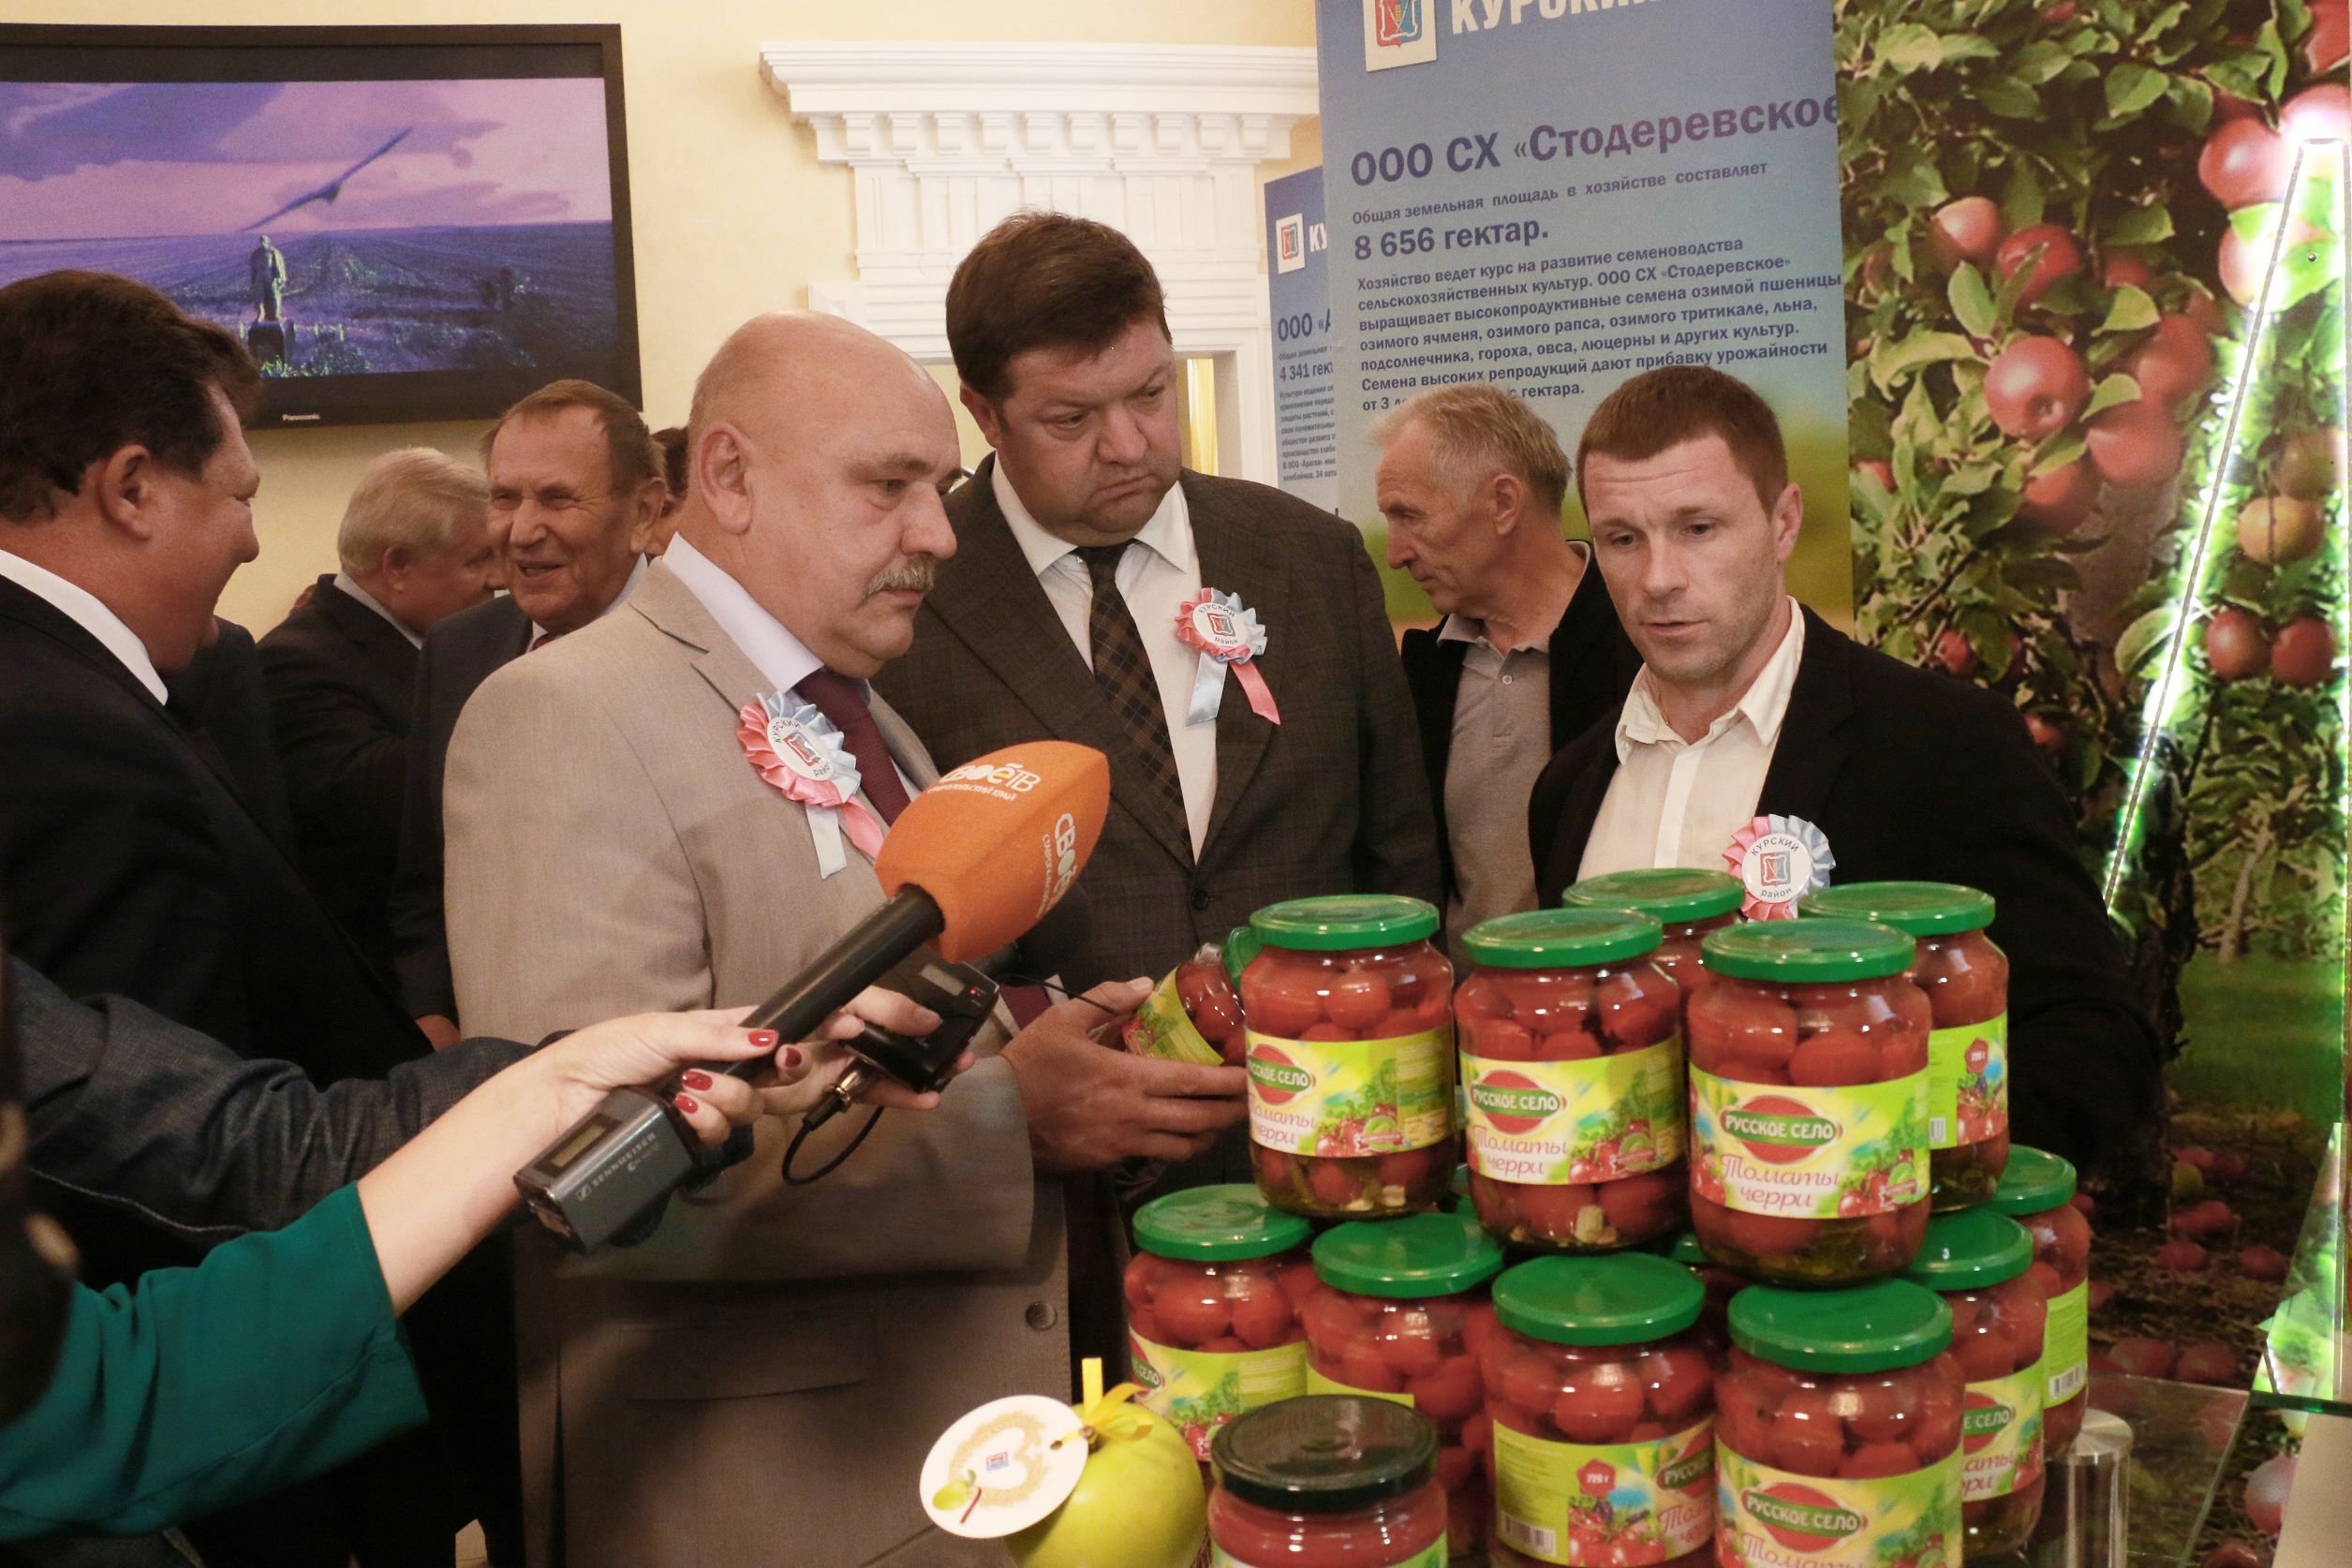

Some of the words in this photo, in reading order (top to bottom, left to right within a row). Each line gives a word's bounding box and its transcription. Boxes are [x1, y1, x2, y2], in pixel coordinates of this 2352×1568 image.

[1351, 142, 1433, 186] ООО
[1446, 132, 1501, 172] СХ
[1353, 208, 1400, 225] Общая
[1405, 197, 1484, 217] земельная
[1493, 188, 1559, 207] площадь
[1567, 185, 1576, 197] в
[1585, 172, 1666, 195] хозяйстве
[1675, 162, 1768, 184] составляет
[1354, 235, 1372, 260] 8
[1380, 227, 1435, 258] 656
[1444, 218, 1548, 250] гектар.
[1357, 272, 1430, 291] Хозяйство
[1435, 267, 1476, 283] ведет
[1480, 263, 1514, 279] курс
[1517, 261, 1536, 274] на
[1541, 253, 1612, 274] развитие
[1617, 239, 1743, 262] семеноводства
[1358, 282, 1528, 312] сельскохозяйственных
[1532, 276, 1593, 294] культур.
[1597, 270, 1631, 286] ООО
[1635, 266, 1657, 282] СХ
[1661, 256, 1791, 279] «Стодеревское»
[1359, 311, 1451, 332] выращивает
[1455, 295, 1621, 321] высокопродуктивные
[1625, 288, 1686, 306] семена
[1692, 278, 1754, 299] озимой
[1759, 274, 1842, 292] пшеницы
[1278, 312, 1313, 342] ООО
[1360, 334, 1419, 351] озимого
[1423, 329, 1483, 346] ячменя,
[1487, 322, 1549, 339] озимого
[1555, 318, 1605, 336] рапса,
[1609, 311, 1677, 328] озимого
[1680, 303, 1768, 323] тритикале,
[1773, 299, 1817, 314] льна,
[1361, 350, 1474, 372] подсолнечника,
[1478, 345, 1532, 362] гороха,
[1536, 341, 1577, 356] овса,
[1581, 334, 1655, 351] люцерны
[1661, 333, 1670, 345] и
[1674, 329, 1729, 346] других
[1733, 322, 1799, 341] культур.
[1289, 362, 1310, 380] 341
[1362, 376, 1416, 392] Семена
[1421, 369, 1484, 386] высоких
[1488, 359, 1587, 382] репродукций
[1591, 358, 1632, 374] дают
[1636, 350, 1712, 371] прибавку
[1716, 343, 1827, 365] урожайности
[1363, 399, 1378, 411] от
[1381, 396, 1390, 409] 3
[1521, 381, 1585, 398] гектара.
[1760, 887, 1793, 898] район
[1277, 1070, 1309, 1087] СЕЛО
[1472, 1087, 1517, 1110] РУССКОЕ
[1519, 1094, 1559, 1111] СЕЛО
[1474, 1125, 1568, 1155] Томаты
[1724, 1113, 1787, 1139] РУССКОЕ
[1791, 1121, 1834, 1140] СЕЛО
[1487, 1154, 1545, 1177] черри
[1720, 1152, 1841, 1186] Томаты
[1739, 1184, 1813, 1209] черри
[1975, 1411, 2009, 1428] СЕЛО
[1746, 1495, 1809, 1528] РУССКОЕ
[1812, 1512, 1858, 1531] СЕЛО
